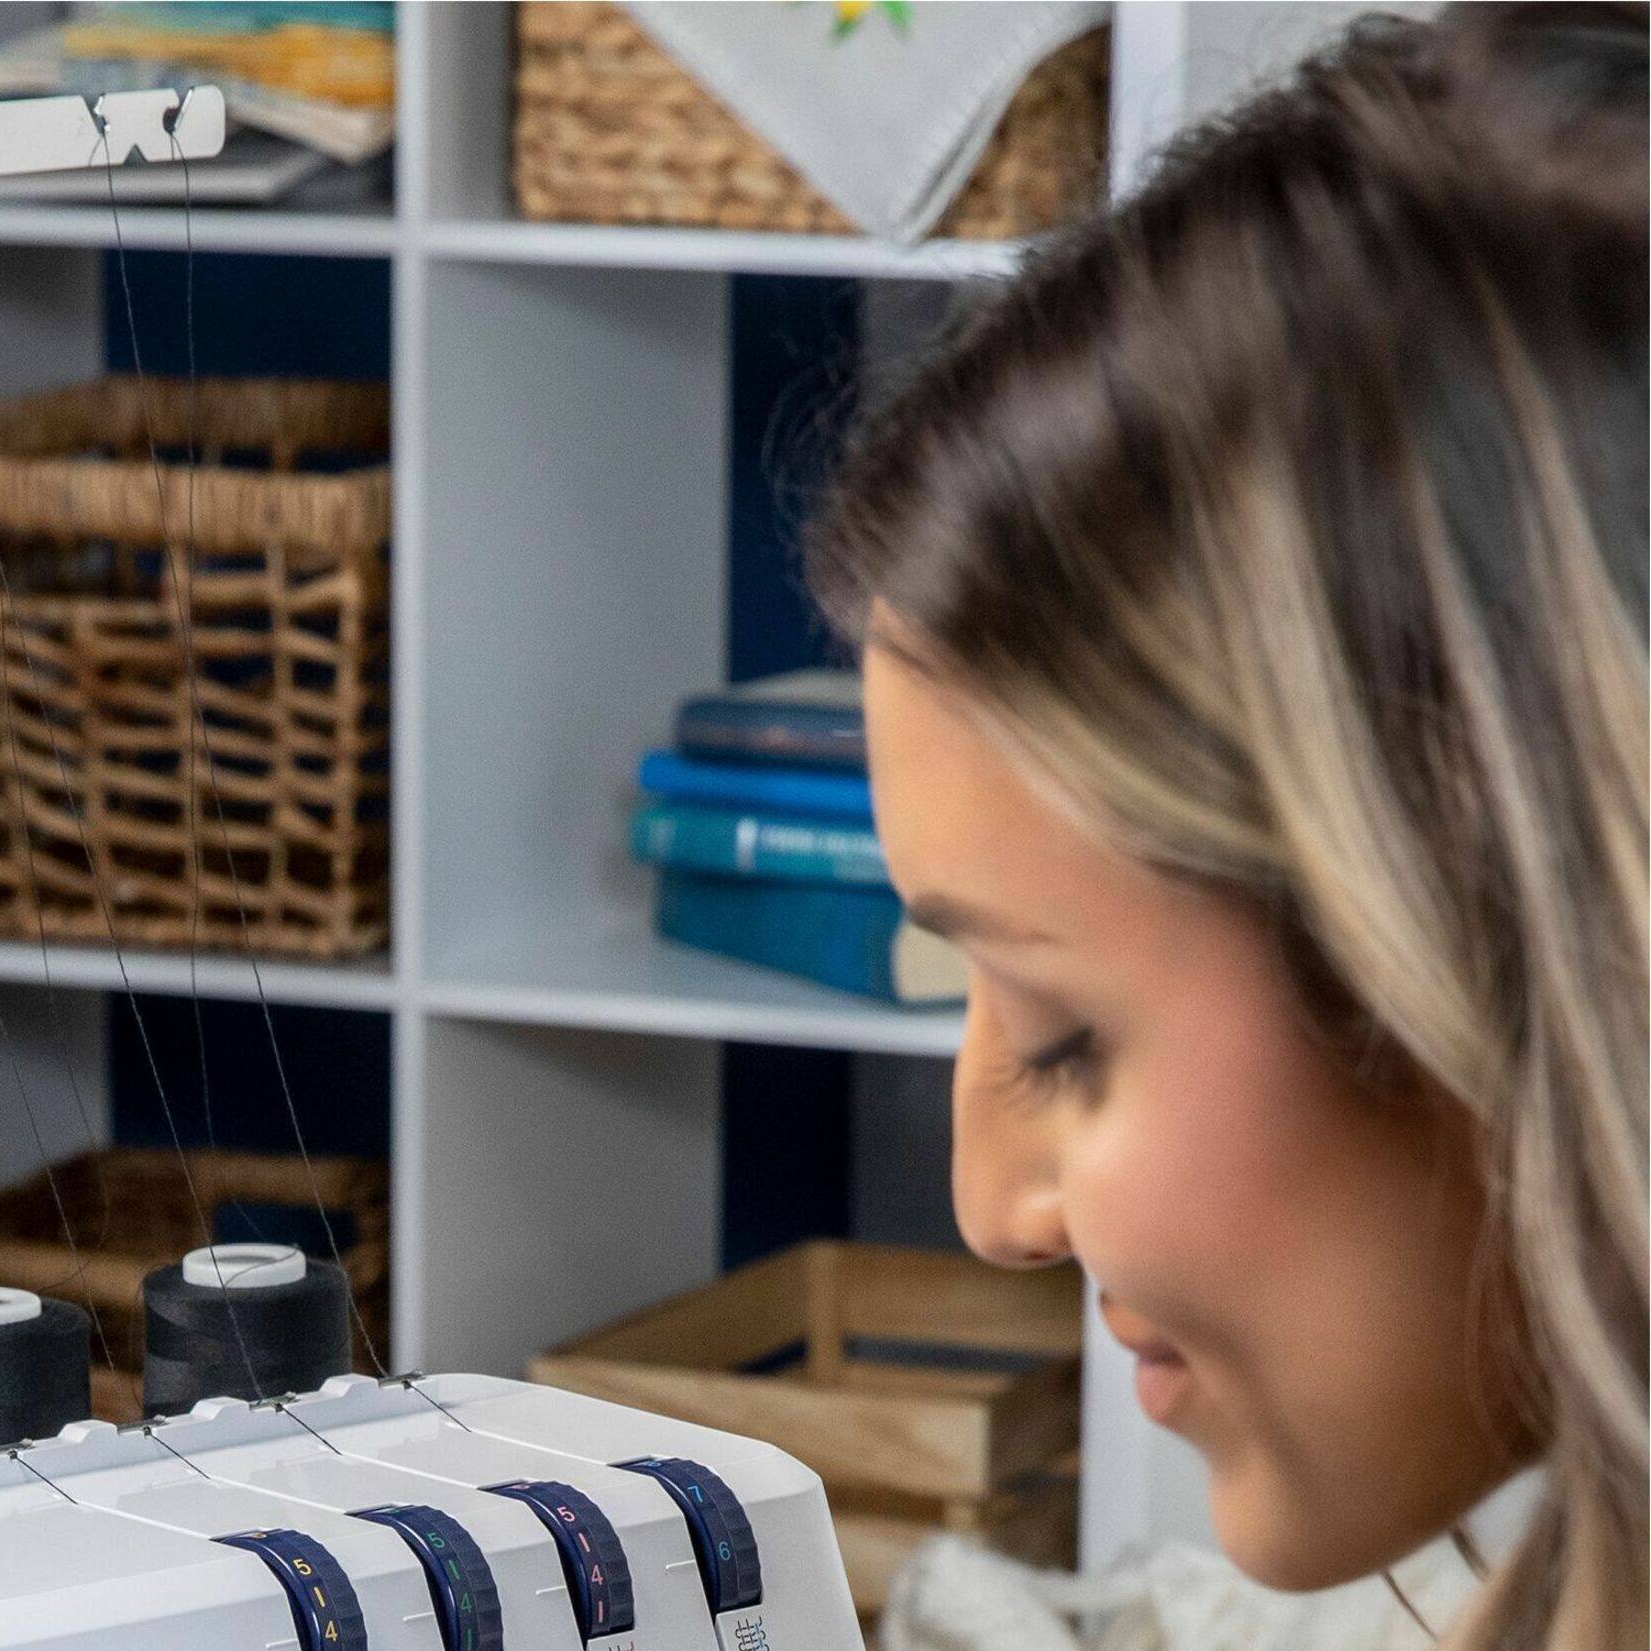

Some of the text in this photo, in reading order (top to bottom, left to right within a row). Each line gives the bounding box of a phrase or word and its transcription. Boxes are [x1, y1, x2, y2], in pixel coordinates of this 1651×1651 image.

[687, 1484, 703, 1503] 7
[556, 1506, 576, 1522] 5
[426, 1532, 446, 1549] 5
[718, 1540, 731, 1561] 6
[292, 1558, 312, 1576] 5
[591, 1564, 604, 1585] 4
[460, 1592, 473, 1613] 4
[325, 1620, 338, 1642] 4
